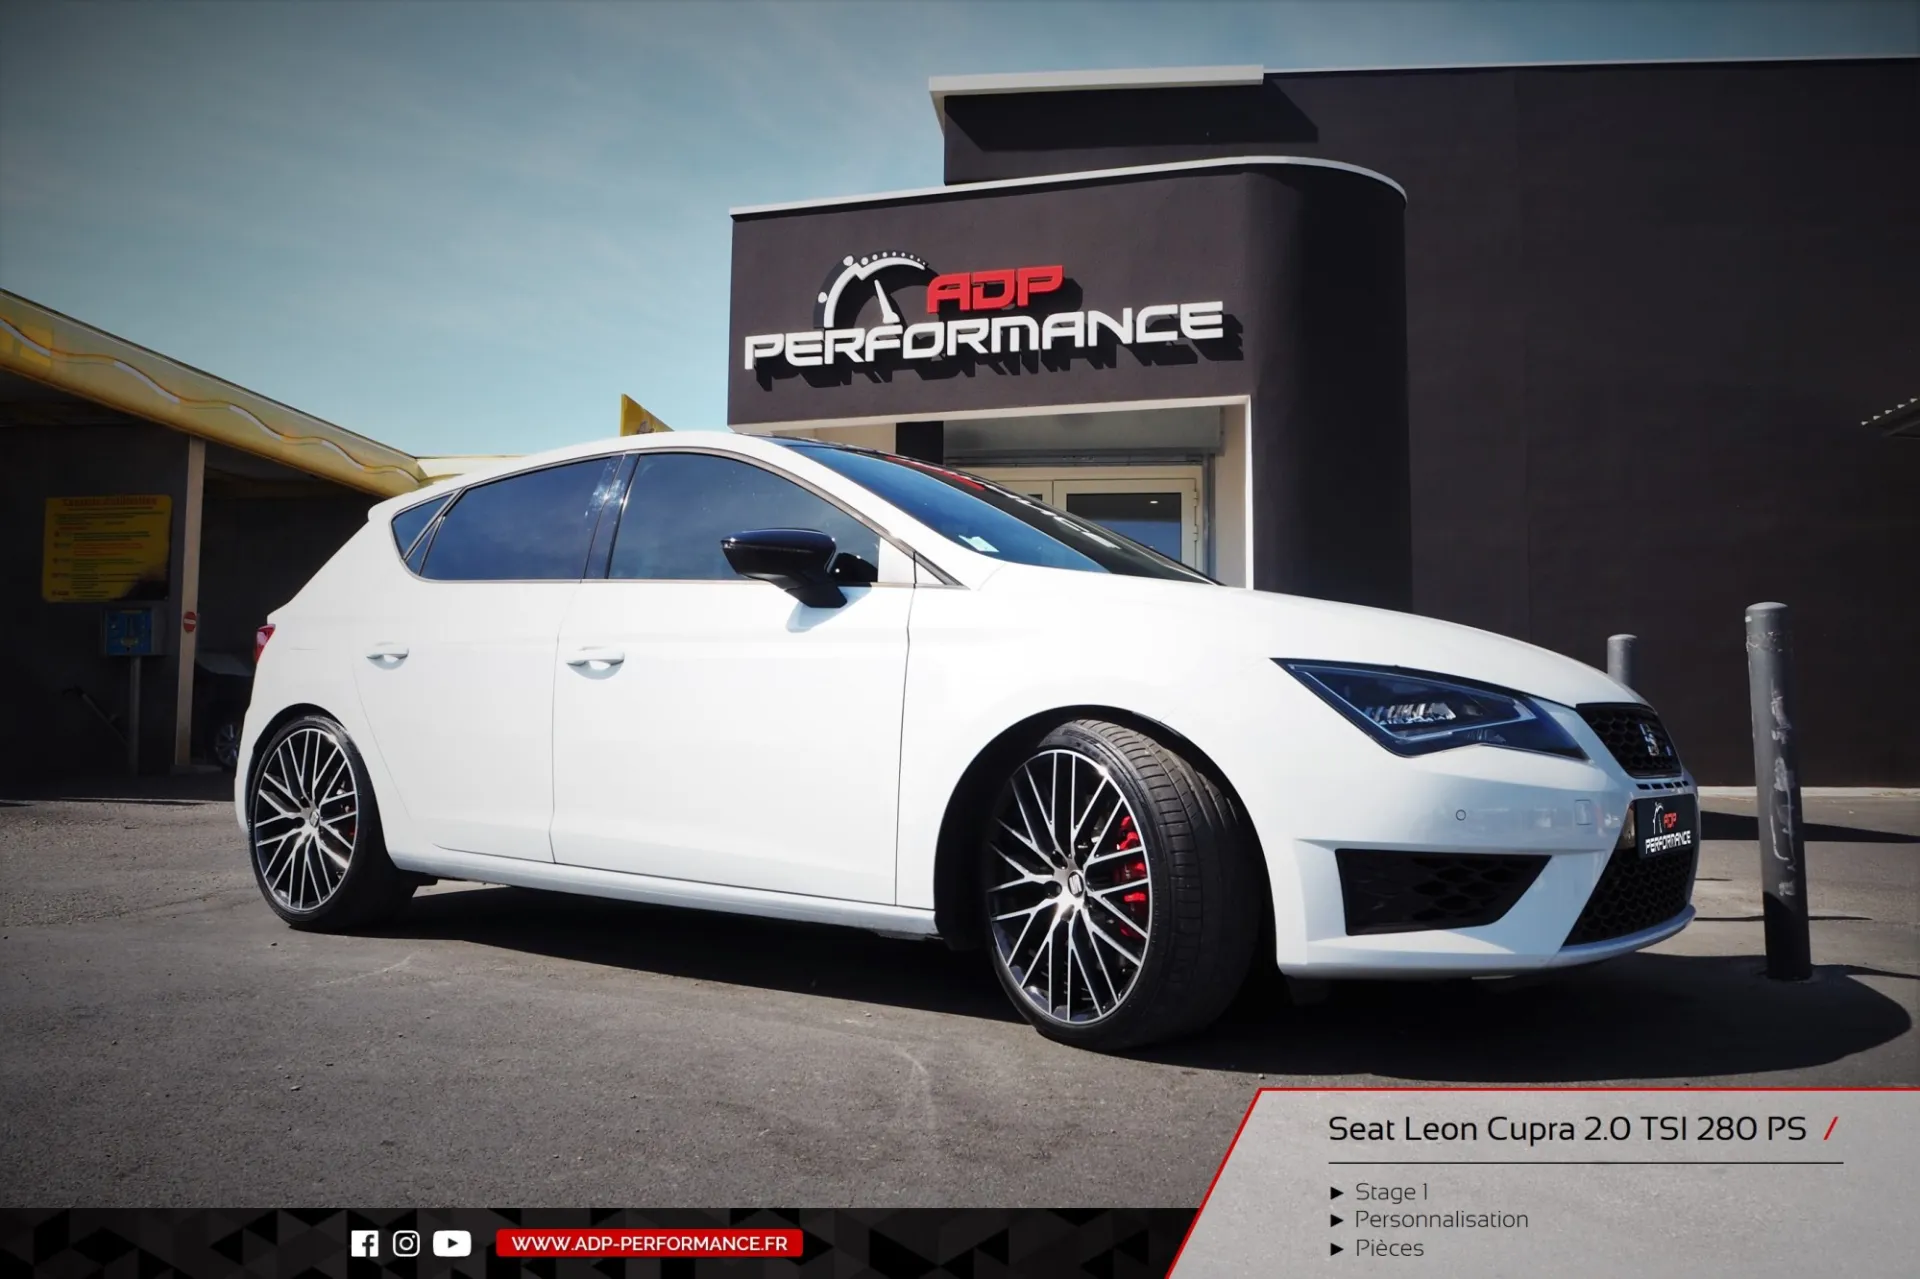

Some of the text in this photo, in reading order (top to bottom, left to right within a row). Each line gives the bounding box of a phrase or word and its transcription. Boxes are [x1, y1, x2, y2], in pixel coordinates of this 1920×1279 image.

[926, 265, 1063, 313] ADP
[744, 301, 1224, 370] PERFORMANCE
[1663, 812, 1677, 828] ADP
[1645, 830, 1692, 854] PERFORMANCE
